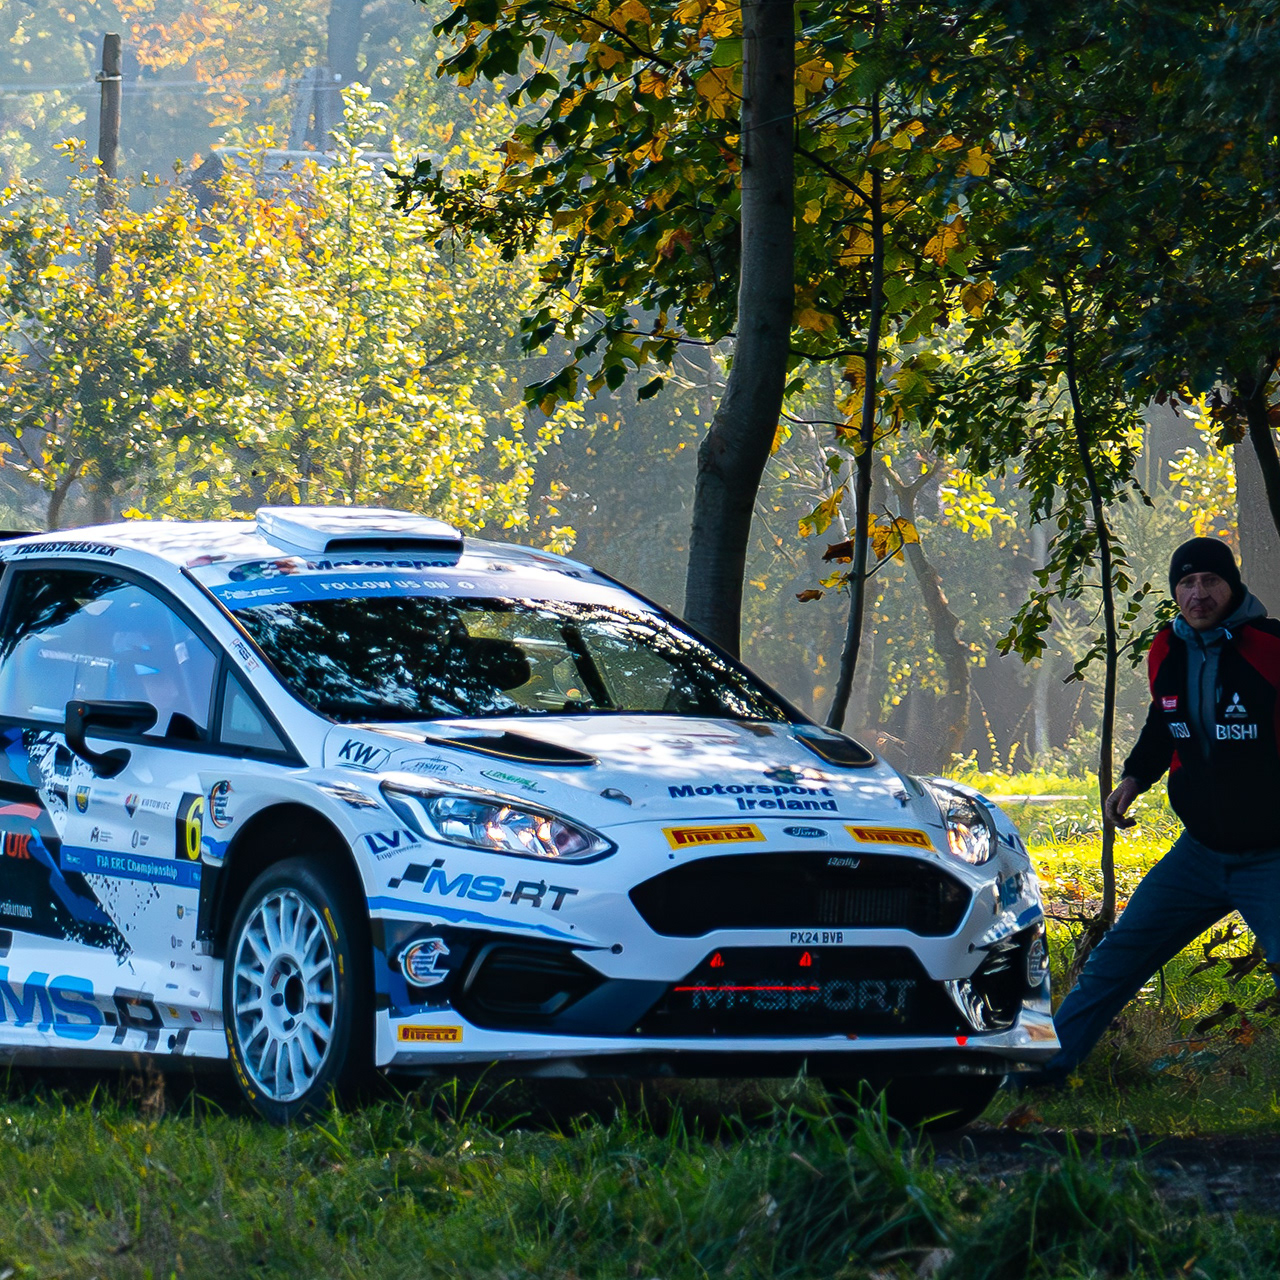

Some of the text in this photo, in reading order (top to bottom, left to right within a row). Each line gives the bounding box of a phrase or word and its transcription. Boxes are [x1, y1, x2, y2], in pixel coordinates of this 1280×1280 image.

[320, 581, 392, 591] FOLLOW
[393, 580, 422, 589] US
[423, 580, 450, 589] ON
[1216, 723, 1258, 740] BISHI
[338, 739, 381, 765] KW
[414, 762, 449, 772] FISHER
[668, 783, 834, 799] Motorsport
[141, 799, 173, 810] KATOWICE
[736, 797, 839, 812] Ireland
[186, 797, 204, 860] 6
[671, 826, 755, 845] PIRELLI
[792, 827, 820, 836] Ford
[364, 830, 419, 855] LVI
[853, 828, 929, 847] PIRELLI
[110, 857, 126, 871] ERC
[127, 859, 178, 880] Championship
[828, 857, 861, 869] Rally
[422, 869, 579, 912] MS-RT
[790, 932, 844, 944] PX24 BVB
[691, 979, 917, 1011] M-SPORT
[402, 1027, 458, 1040] PIRELLI
